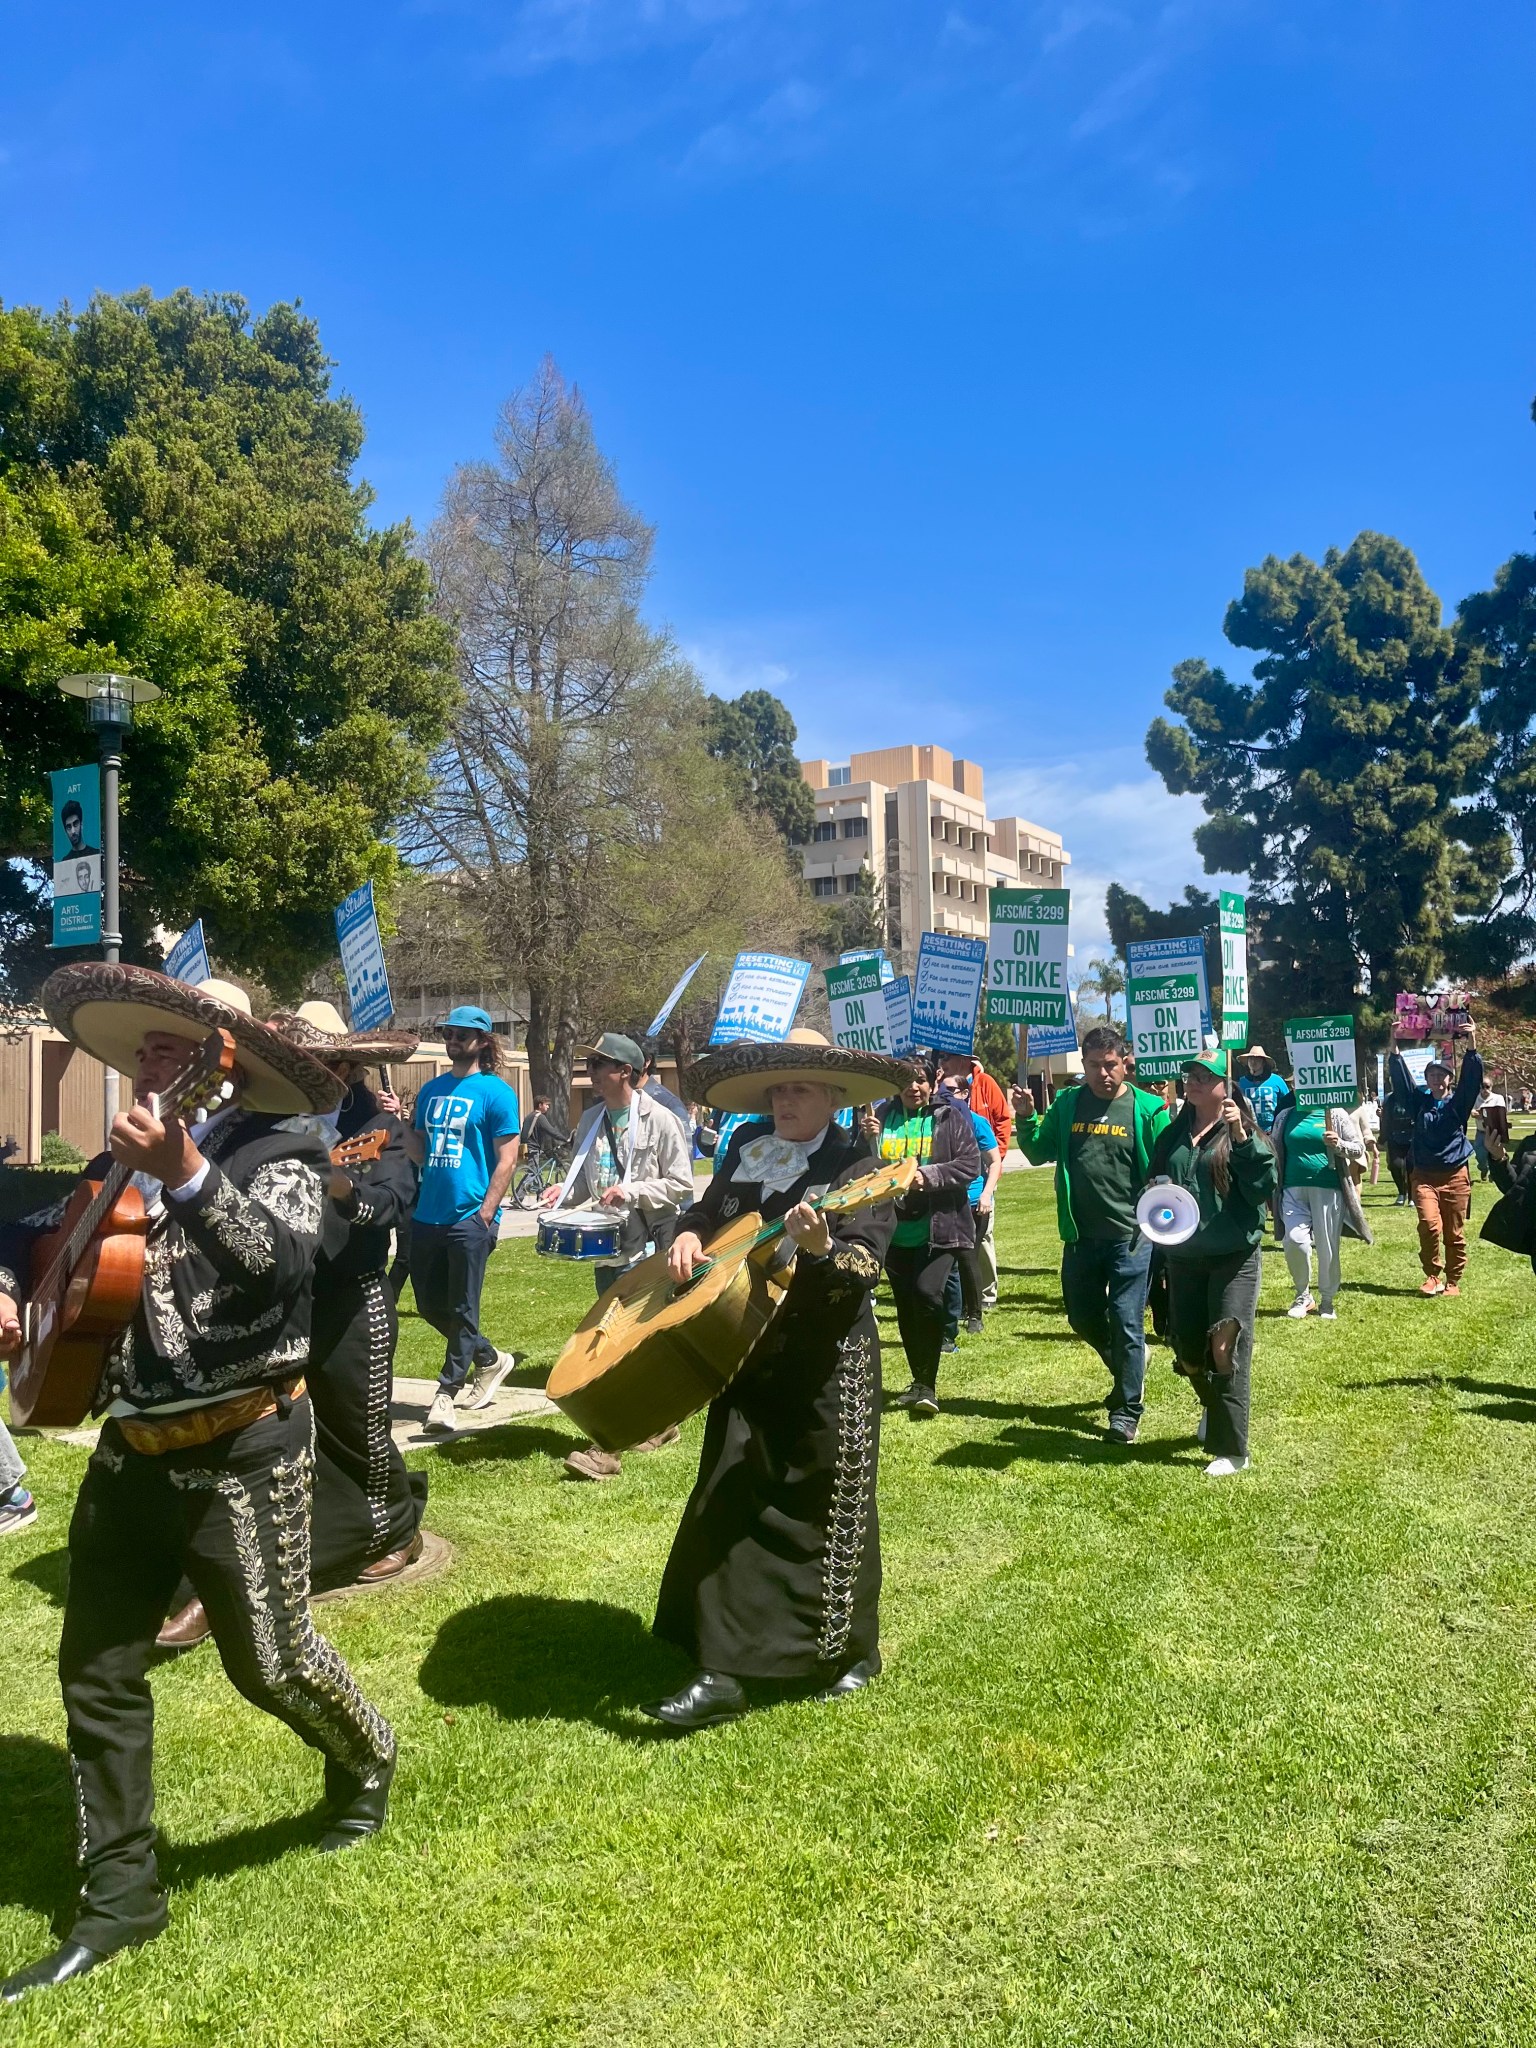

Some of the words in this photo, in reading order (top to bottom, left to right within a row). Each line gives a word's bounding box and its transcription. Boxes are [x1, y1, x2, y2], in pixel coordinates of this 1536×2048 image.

[67, 783, 81, 794] ART
[61, 904, 80, 915] ARTS
[995, 904, 1033, 920] AFSCME
[1036, 905, 1064, 920] 3299
[61, 914, 93, 926] DISTRICT
[923, 935, 971, 951] RESETTING
[1013, 929, 1040, 956] ON
[1131, 941, 1187, 954] RESETTING
[841, 953, 875, 964] RESETTING
[936, 946, 970, 957] PRIORITIES
[1148, 948, 1187, 957] PRIORITIES
[1224, 939, 1234, 970] ON
[740, 955, 794, 968] RESETTING
[752, 962, 791, 974] PRIORITIES
[951, 964, 976, 973] RESEARCH
[769, 976, 796, 986] RESEARCH
[949, 977, 974, 985] STUDENTS
[993, 959, 1061, 989] STRIKE
[766, 987, 793, 997] STUDENTS
[830, 978, 856, 996] AFSCME
[856, 973, 878, 990] 3299
[1224, 975, 1245, 1005] RIKE
[762, 997, 788, 1007] PATIENTS
[948, 990, 972, 999] PATIENTS
[1135, 988, 1170, 1002] AFSCME
[1172, 986, 1194, 999] 3299
[845, 1000, 866, 1026] ON
[990, 997, 1062, 1018] SOLIDARITY
[1154, 1006, 1178, 1028] ON
[743, 1027, 783, 1041] Professional
[837, 1025, 887, 1052] STRIKE
[912, 1022, 935, 1033] University
[936, 1027, 970, 1040] Professional
[916, 1029, 938, 1040] Technical
[938, 1034, 970, 1046] Employees
[1296, 1028, 1328, 1040] AFSCME
[1329, 1026, 1350, 1038] 3299
[1137, 1029, 1198, 1053] STRIKE
[1313, 1044, 1334, 1063] ON
[1138, 1061, 1182, 1077] SOLIDAR
[1298, 1064, 1352, 1085] STRIKE
[1246, 1087, 1272, 1100] UP
[1299, 1090, 1354, 1106] SOLIDARITY
[427, 1098, 469, 1126] UP
[1071, 1122, 1085, 1133] WE
[1087, 1123, 1110, 1135] RUN
[1111, 1125, 1128, 1137] UC.
[428, 1127, 463, 1156] TE
